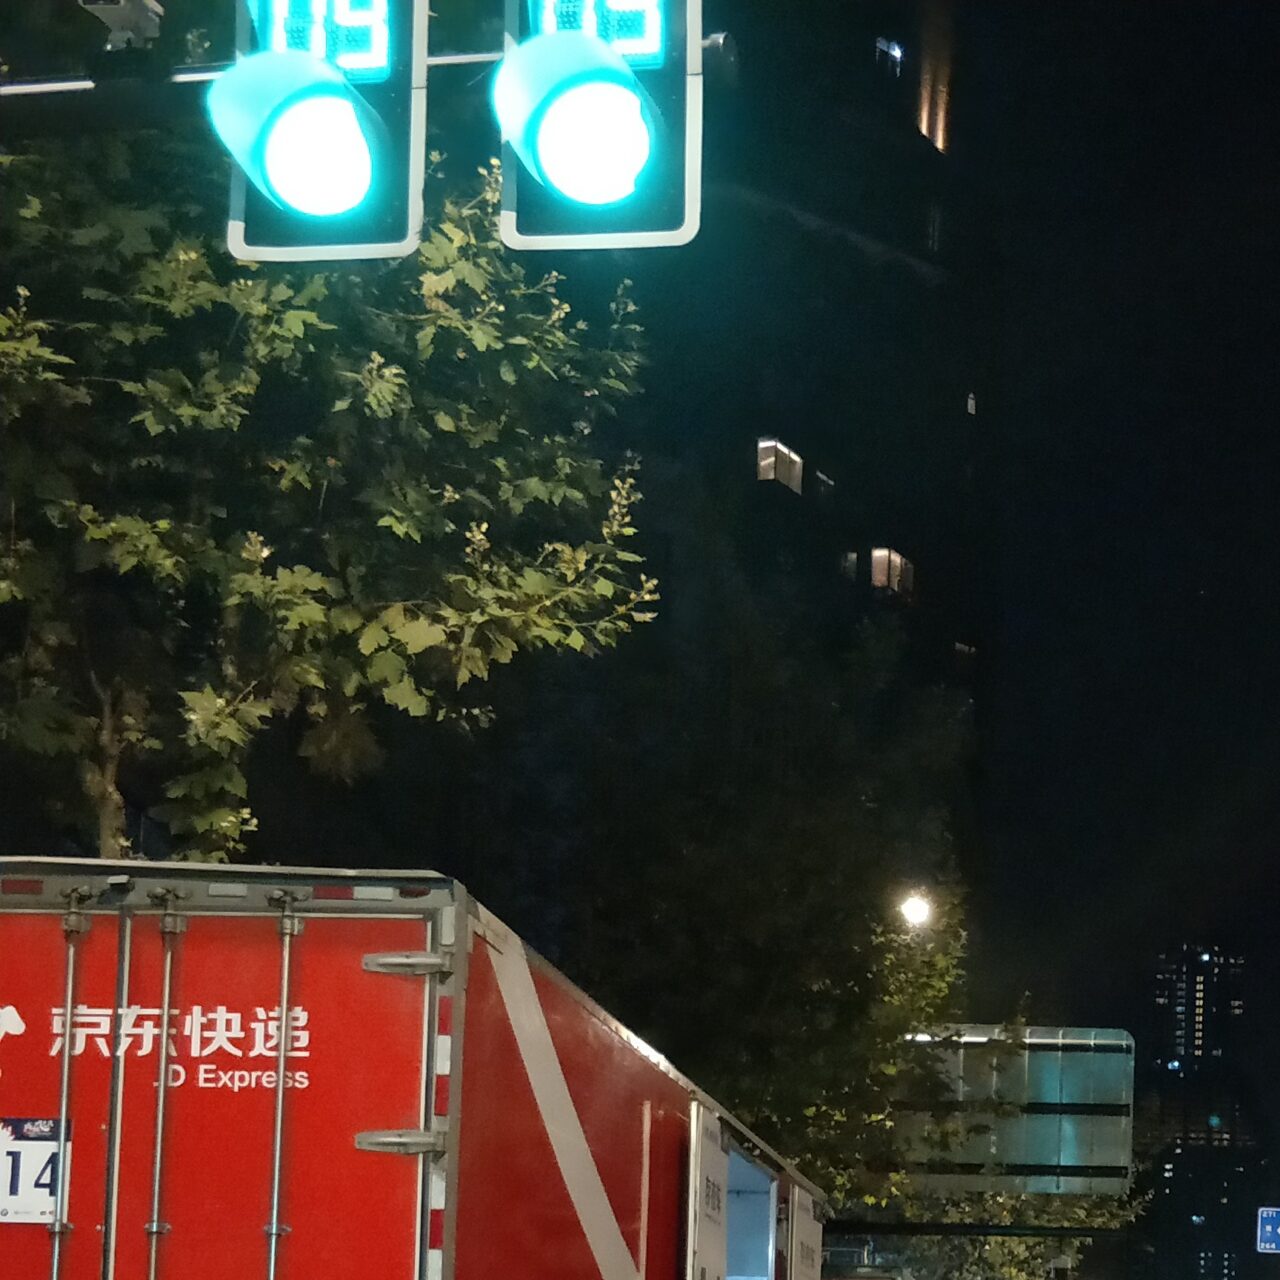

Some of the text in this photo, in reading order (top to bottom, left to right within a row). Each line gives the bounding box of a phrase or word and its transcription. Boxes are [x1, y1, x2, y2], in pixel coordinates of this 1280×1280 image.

[49, 1004, 311, 1058] 京东快递
[153, 1064, 310, 1093] D Express
[5, 1150, 59, 1198] 14
